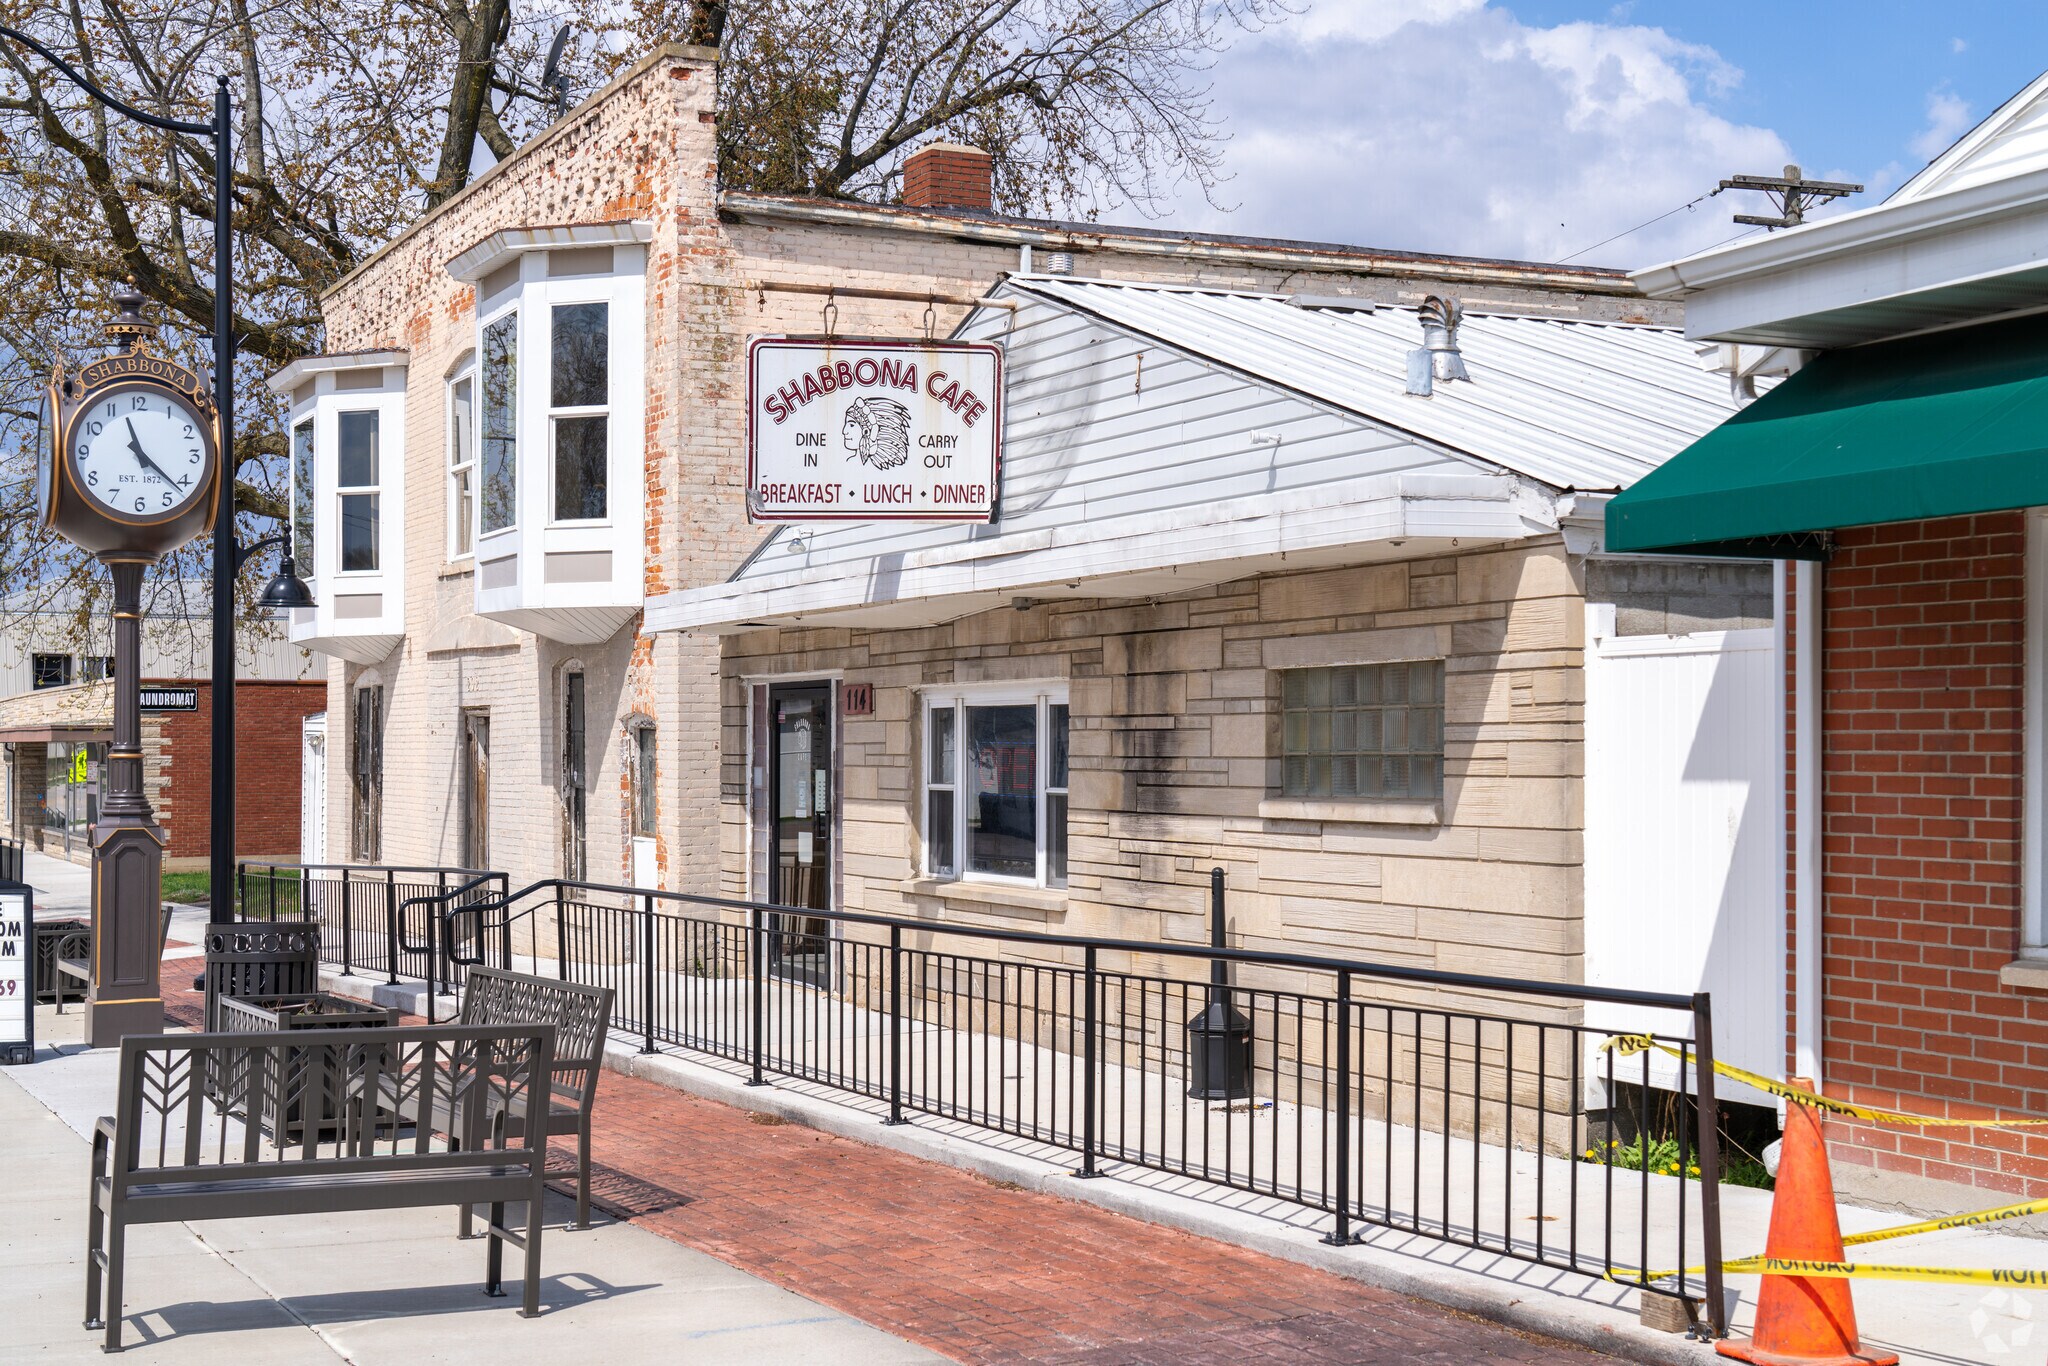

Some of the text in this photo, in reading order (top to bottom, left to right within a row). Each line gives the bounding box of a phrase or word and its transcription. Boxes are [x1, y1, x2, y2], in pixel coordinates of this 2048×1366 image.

[88, 359, 188, 386] SHABBONA
[764, 358, 988, 428] SHABBONA CAFE
[107, 403, 116, 417] 11
[132, 396, 148, 411] 12
[86, 421, 103, 436] 10
[183, 424, 195, 440] 2
[796, 433, 827, 447] DINE
[918, 434, 959, 449] CARRY
[78, 445, 89, 460] 9
[189, 449, 200, 464] 3
[803, 453, 818, 467] IN
[923, 455, 952, 469] OUT
[87, 470, 98, 486] 8
[119, 475, 161, 484] EST. 1872
[176, 473, 194, 487] 4
[108, 489, 120, 504] 7
[162, 492, 173, 506] 5
[760, 484, 985, 504] BREAKFAST LUNCH DINNER
[134, 497, 145, 512] 6
[140, 693, 194, 706] AUNDROMAT
[847, 688, 866, 710] 114
[2, 940, 15, 956] M
